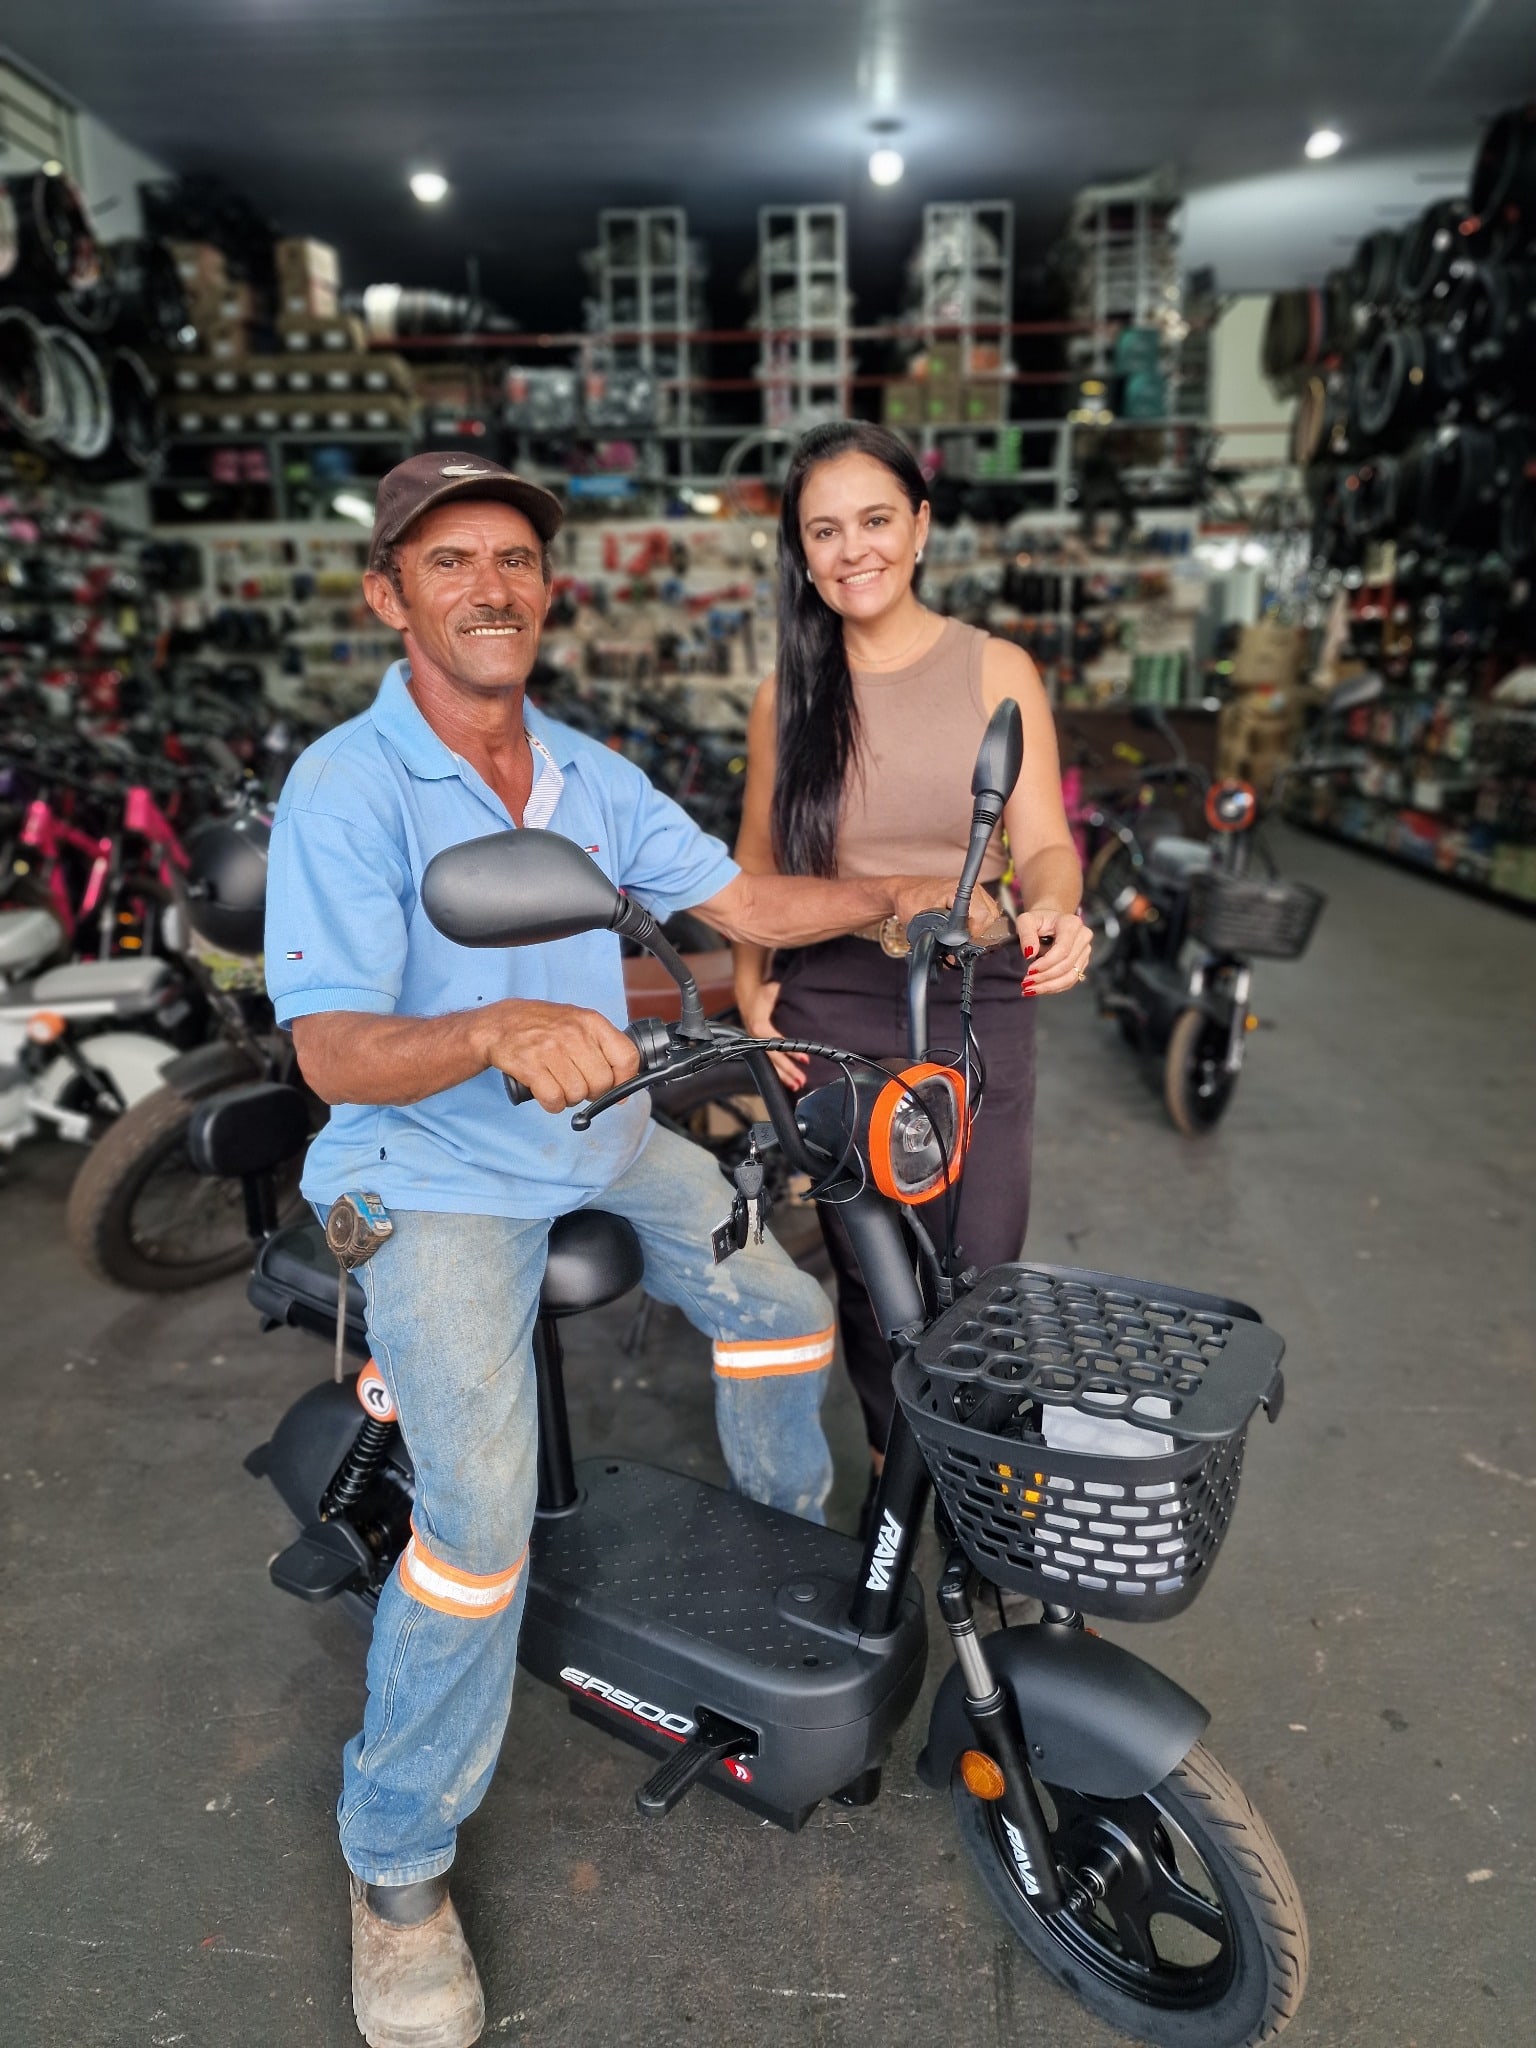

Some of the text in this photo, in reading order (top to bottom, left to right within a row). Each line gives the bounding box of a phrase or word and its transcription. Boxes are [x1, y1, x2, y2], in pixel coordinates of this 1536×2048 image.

[866, 1508, 902, 1590] RAVA
[559, 1666, 694, 1734] ER500
[1001, 1813, 1040, 1895] RAVA
